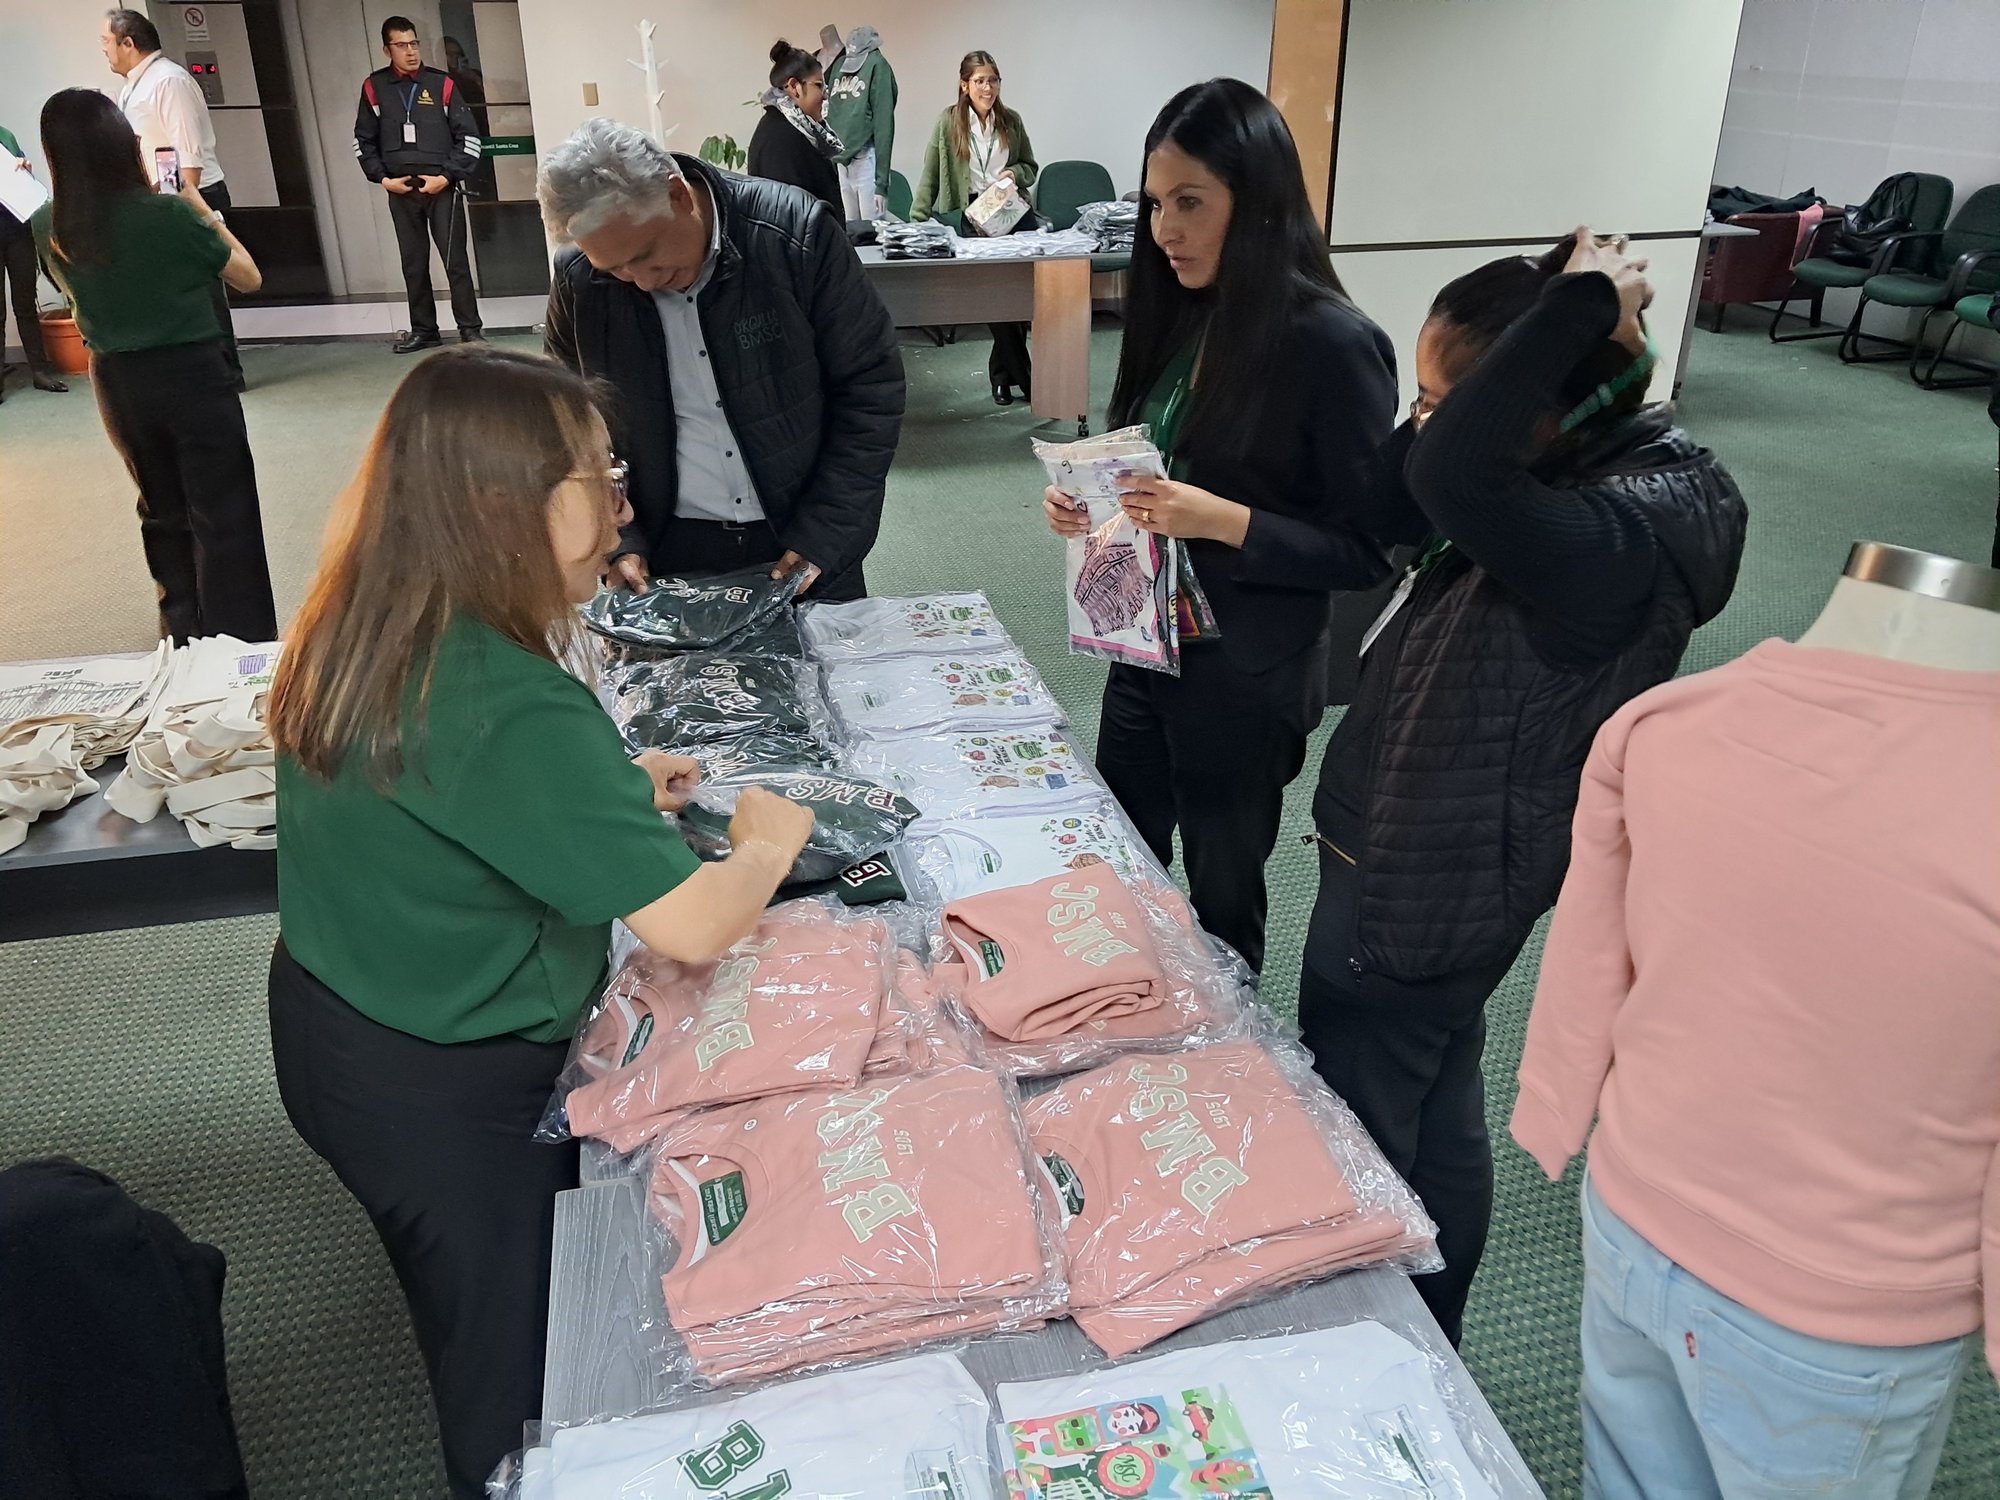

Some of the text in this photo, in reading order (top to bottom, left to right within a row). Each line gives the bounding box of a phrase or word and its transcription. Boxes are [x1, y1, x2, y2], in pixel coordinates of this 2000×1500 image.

[740, 323, 782, 350] BMSC
[699, 658, 762, 715] BMS
[1047, 882, 1140, 967] BMSC
[893, 1128, 914, 1156] 1905
[1129, 1063, 1250, 1216] BMSC
[1205, 1101, 1232, 1129] 1905
[816, 1088, 917, 1244] BMSC
